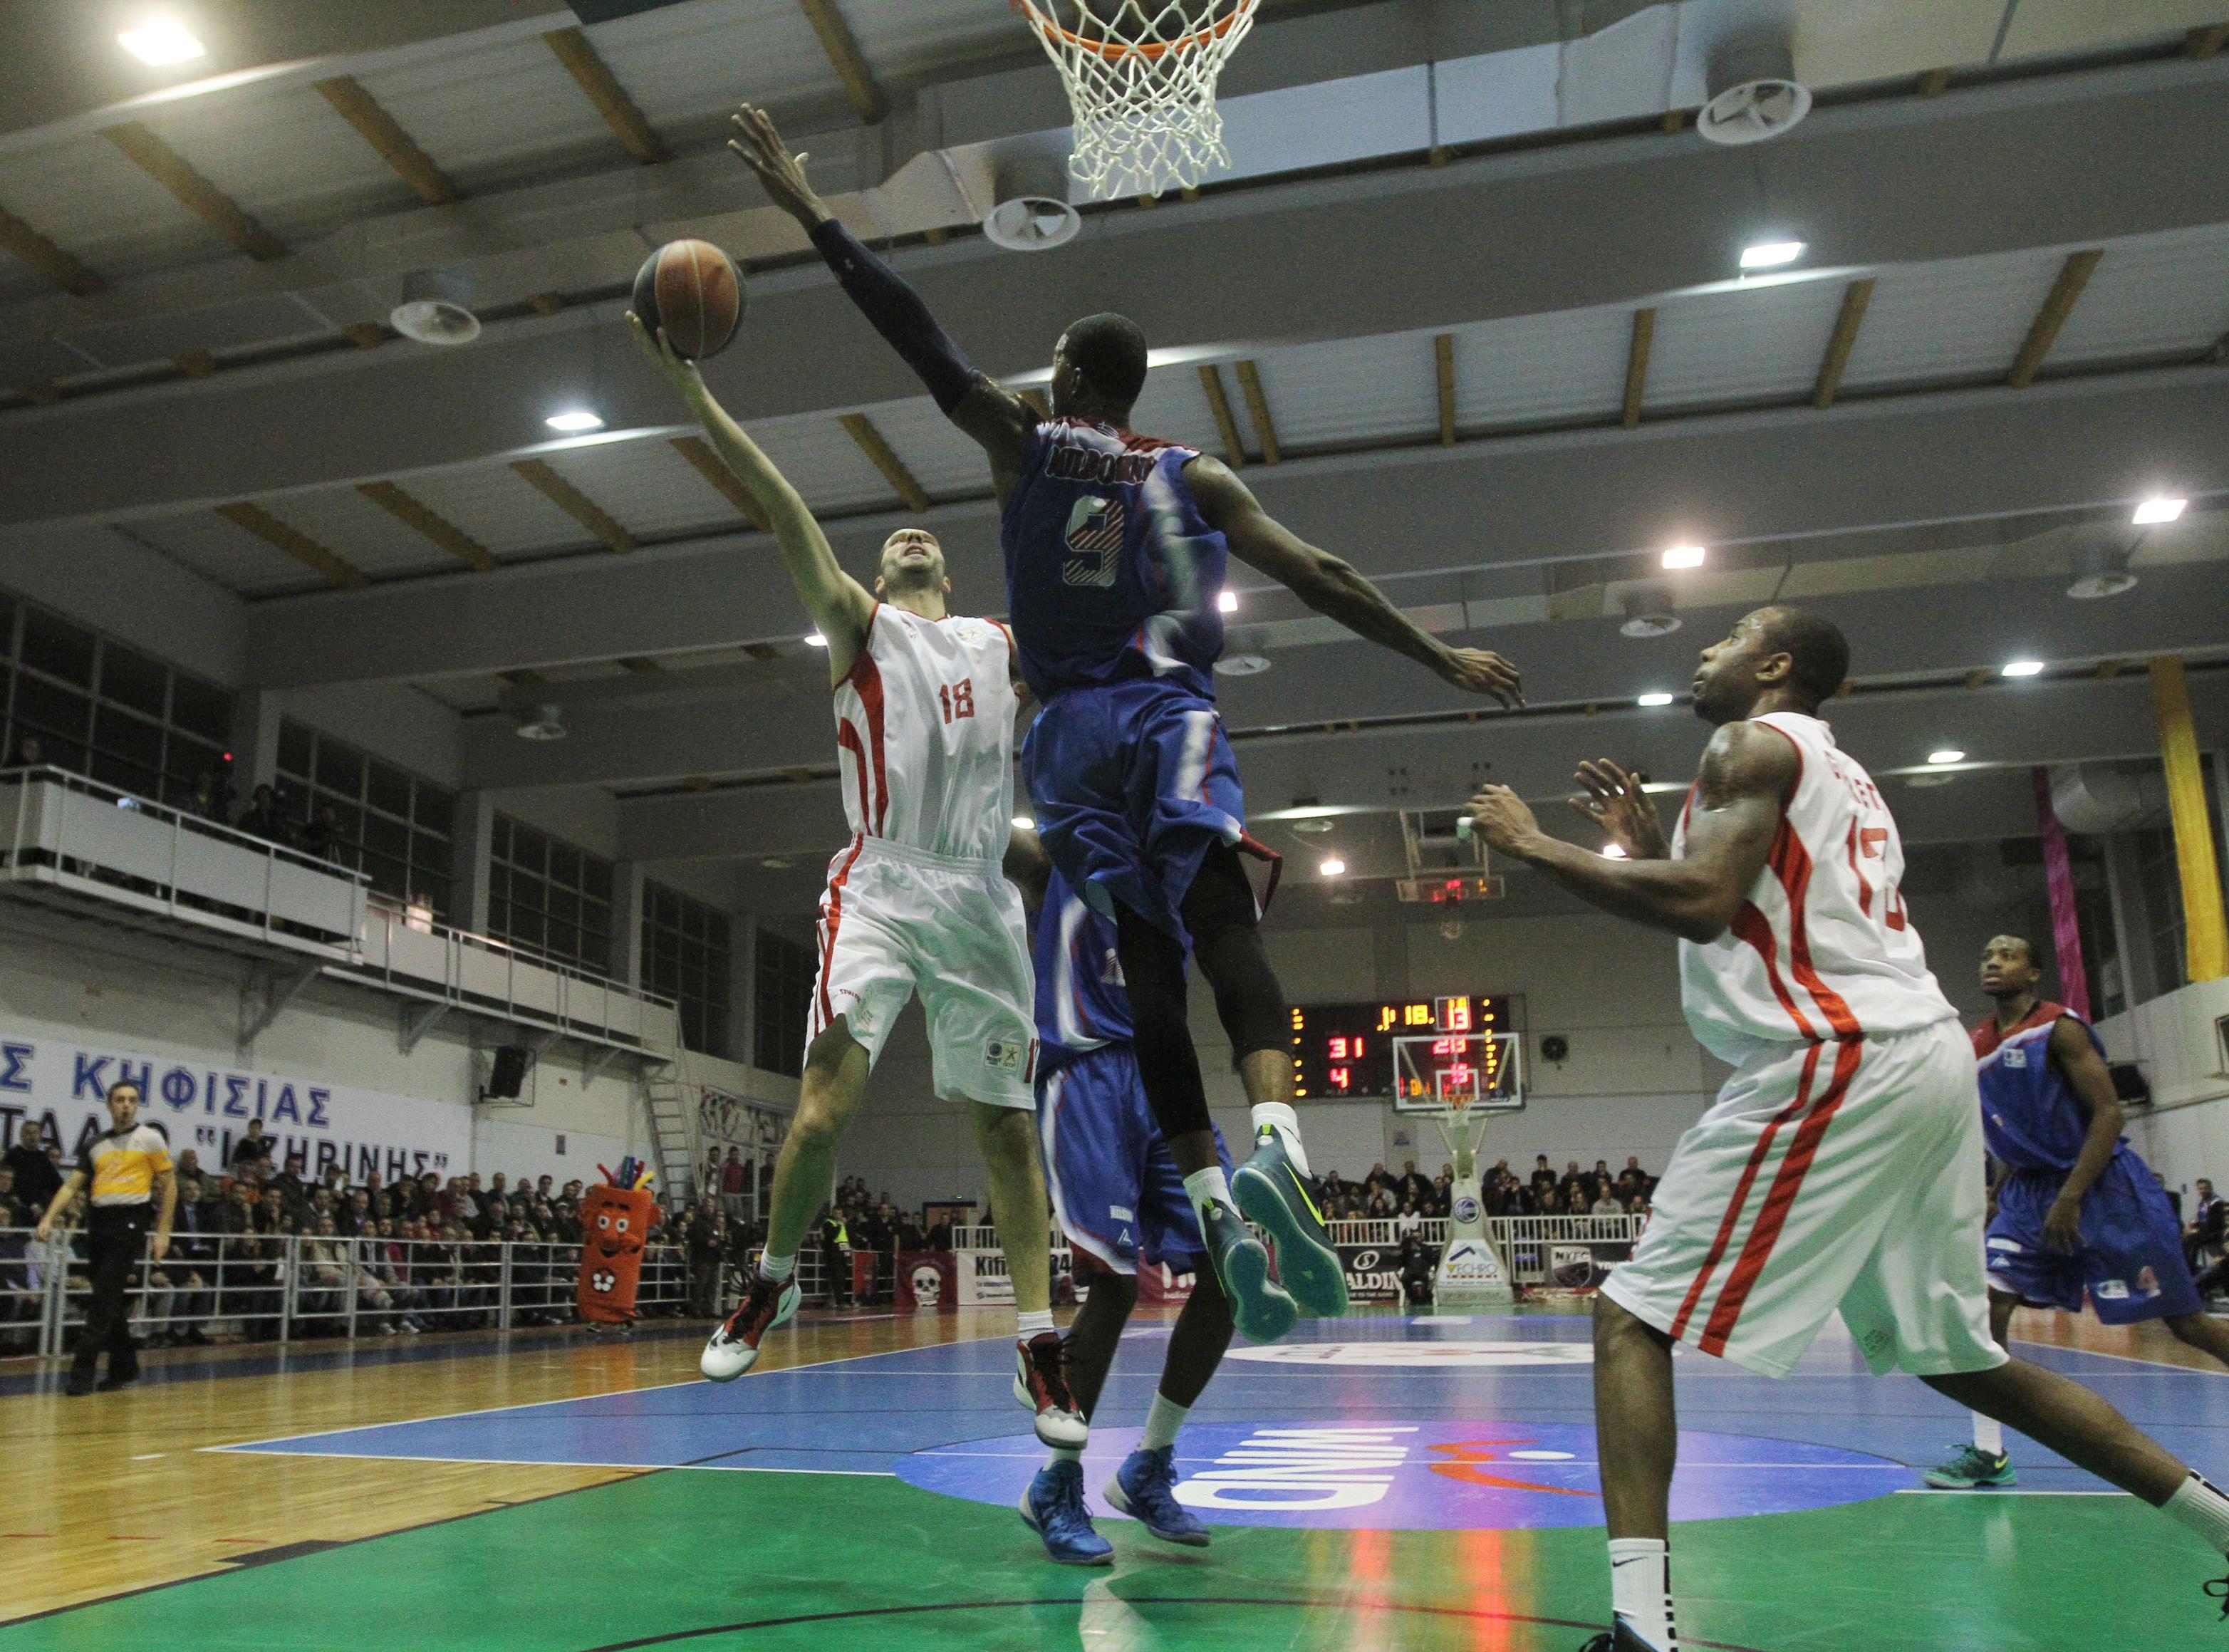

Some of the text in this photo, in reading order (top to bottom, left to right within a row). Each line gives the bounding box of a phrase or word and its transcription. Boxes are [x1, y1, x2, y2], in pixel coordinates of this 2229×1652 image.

[1063, 495, 1124, 586] 9
[939, 678, 974, 724] 18
[1329, 1037, 1363, 1059] 31
[71, 1053, 330, 1128] ΚΗΦΙΣΙΑΣ
[1330, 1069, 1348, 1089] 4
